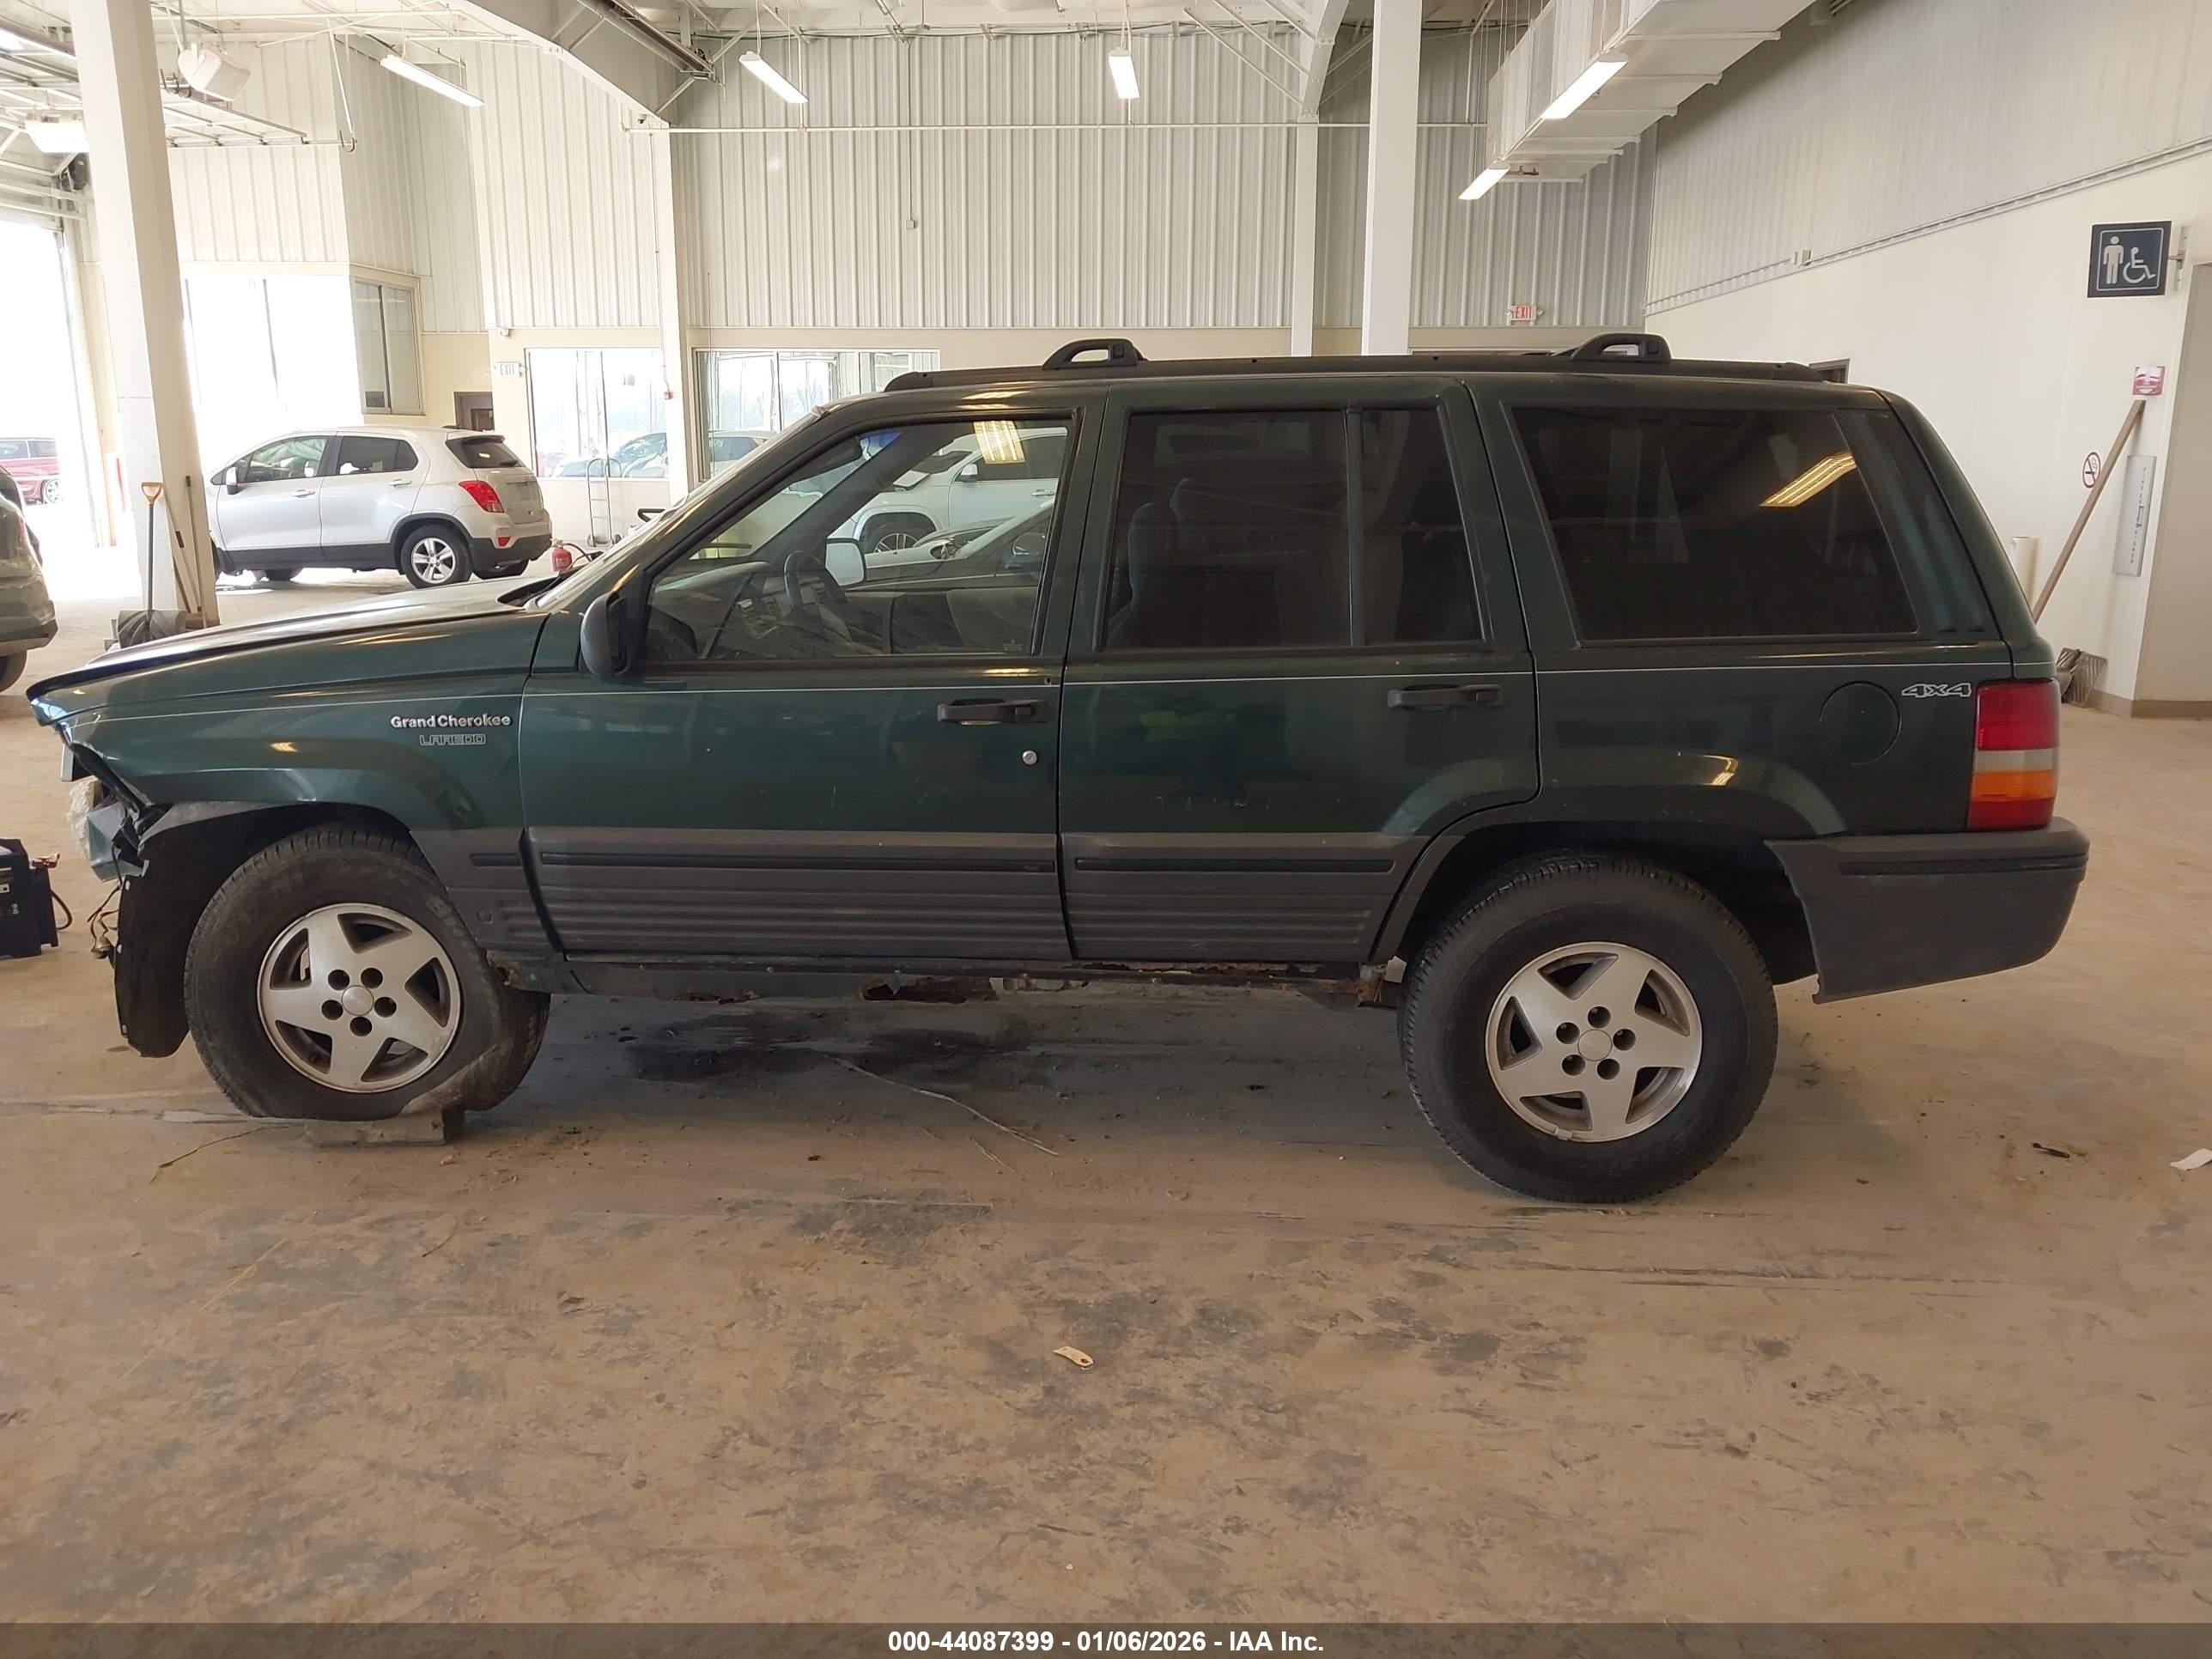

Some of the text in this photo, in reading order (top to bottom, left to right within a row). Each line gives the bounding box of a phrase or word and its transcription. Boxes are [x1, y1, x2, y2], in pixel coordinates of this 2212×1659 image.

[1516, 306, 1532, 319] EXIT
[500, 363, 515, 376] EXIT
[390, 713, 512, 728] Grand Cherokee
[419, 734, 486, 745] LAREDO
